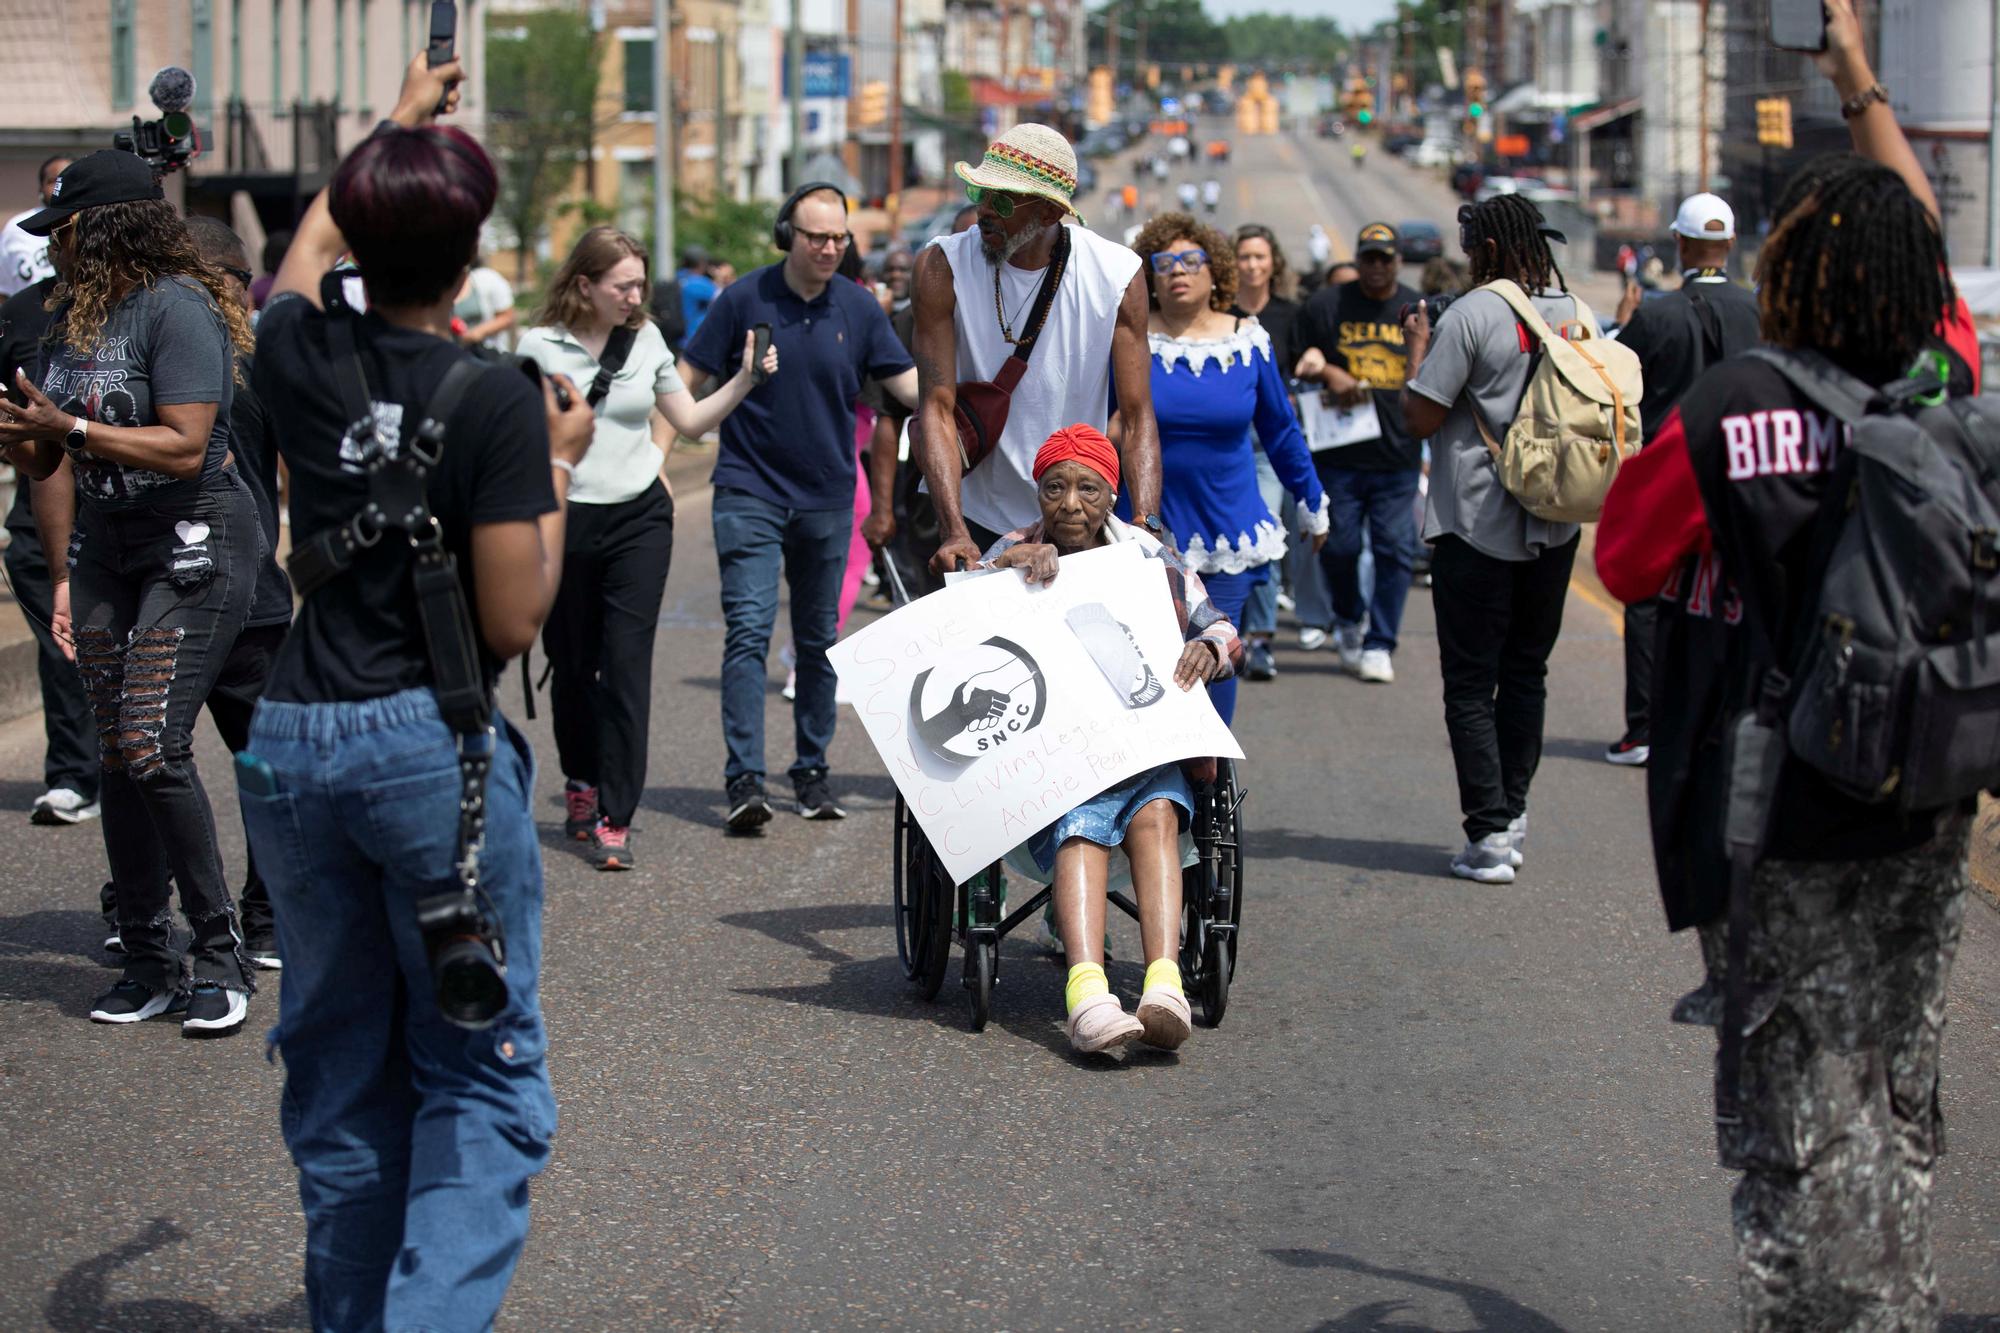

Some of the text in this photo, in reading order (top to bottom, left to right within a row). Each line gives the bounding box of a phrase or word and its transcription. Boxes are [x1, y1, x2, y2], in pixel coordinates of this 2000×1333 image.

[853, 618, 968, 687] Save
[977, 703, 1030, 751] SNCC
[1001, 775, 1081, 837] Annie
[1084, 737, 1139, 781] Pearl
